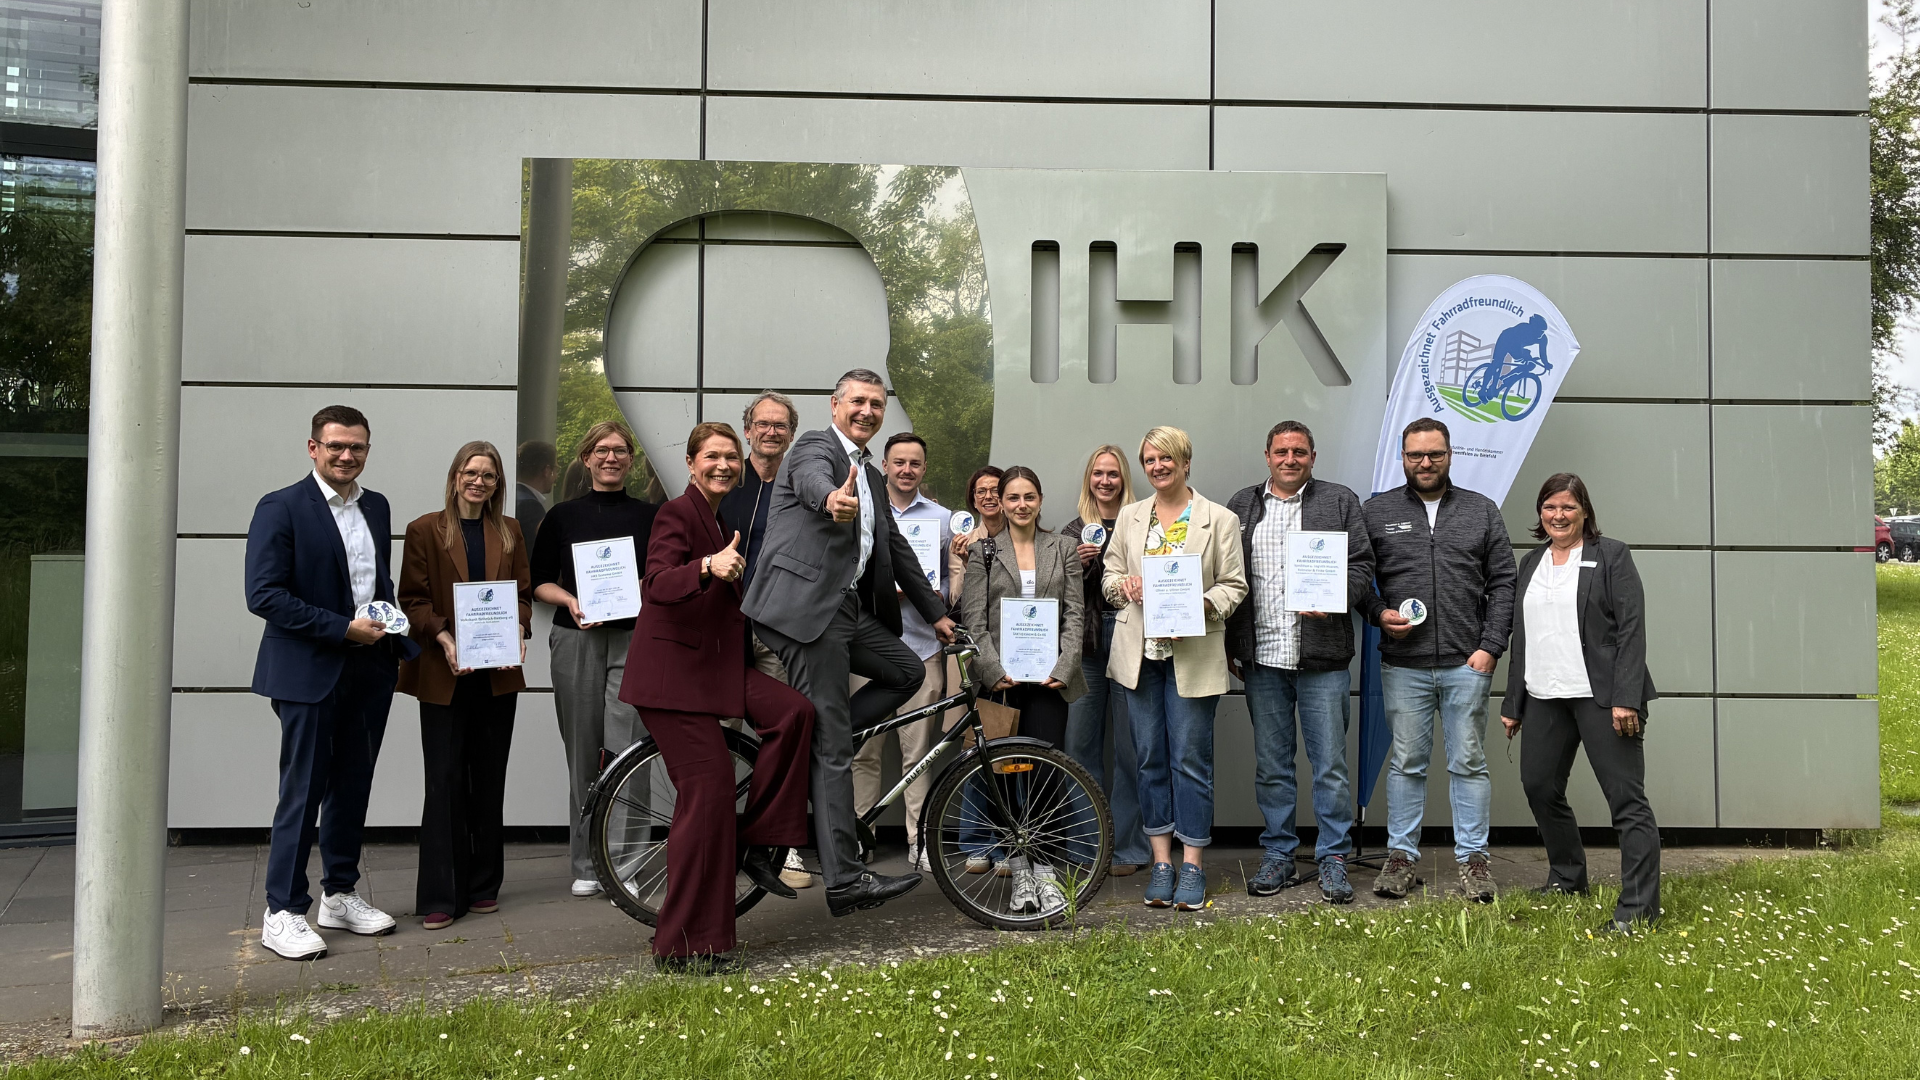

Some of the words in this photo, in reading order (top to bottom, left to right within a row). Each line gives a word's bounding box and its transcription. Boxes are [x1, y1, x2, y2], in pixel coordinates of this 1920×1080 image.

[1031, 240, 1352, 386] IHK
[1431, 297, 1525, 331] Fahrradfreundlich
[1418, 332, 1445, 414] Ausgezeichnet
[905, 748, 941, 785] BUFFALO
